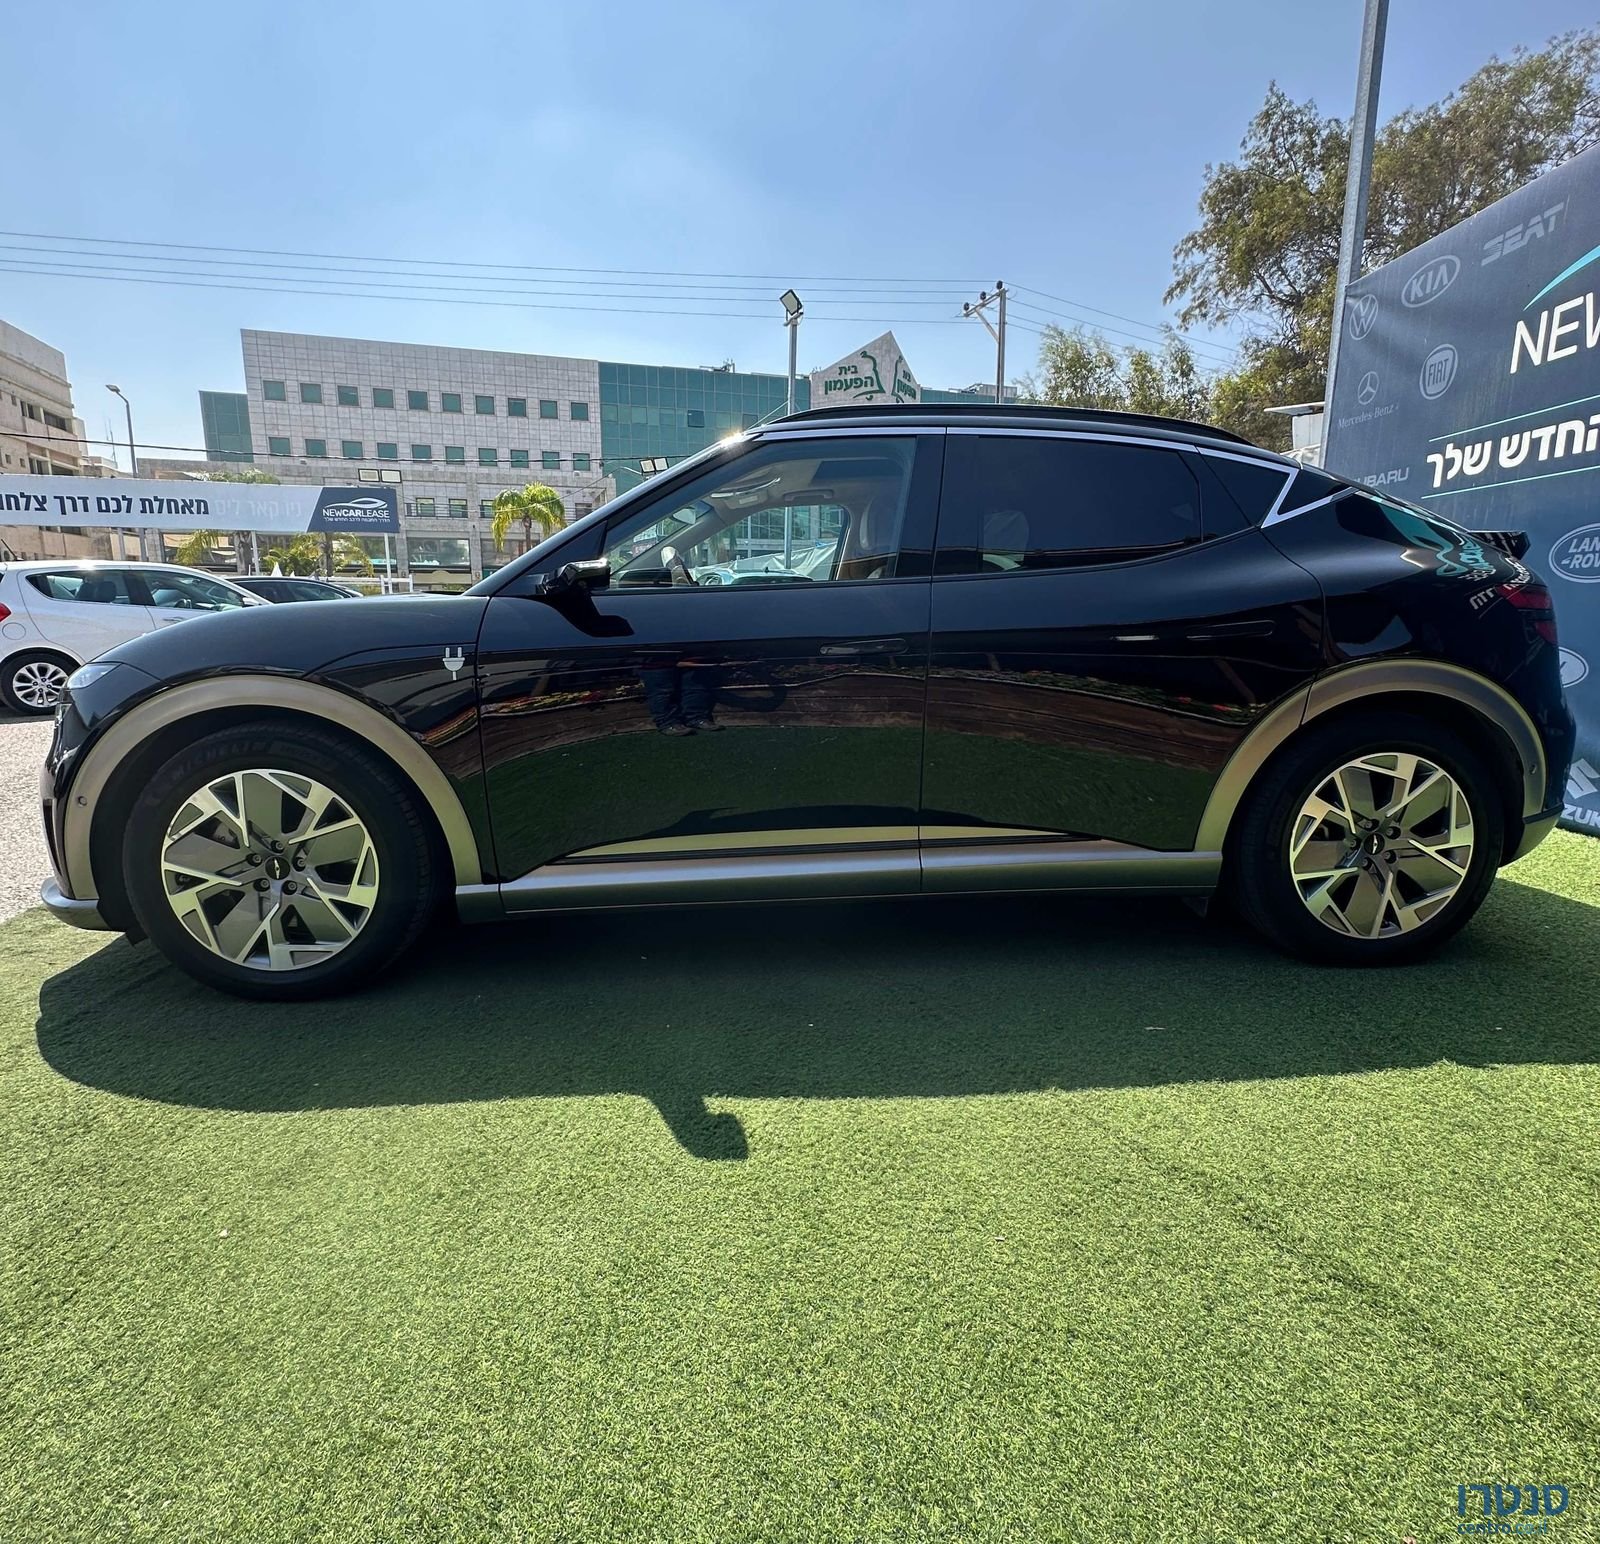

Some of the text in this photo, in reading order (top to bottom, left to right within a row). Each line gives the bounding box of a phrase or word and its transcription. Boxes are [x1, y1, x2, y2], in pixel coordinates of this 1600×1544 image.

[1481, 201, 1564, 266] SEAT
[1410, 263, 1449, 301] KIA
[838, 365, 858, 375] בית
[1427, 358, 1449, 387] FIAT
[825, 376, 874, 395] הפעמון
[1426, 440, 1492, 488] שלך
[1354, 467, 1409, 487] UBARU
[53, 496, 89, 515] דרך
[96, 495, 133, 514] לכם
[139, 496, 210, 515] מאחלת
[322, 509, 390, 518] NEWCARLEASE
